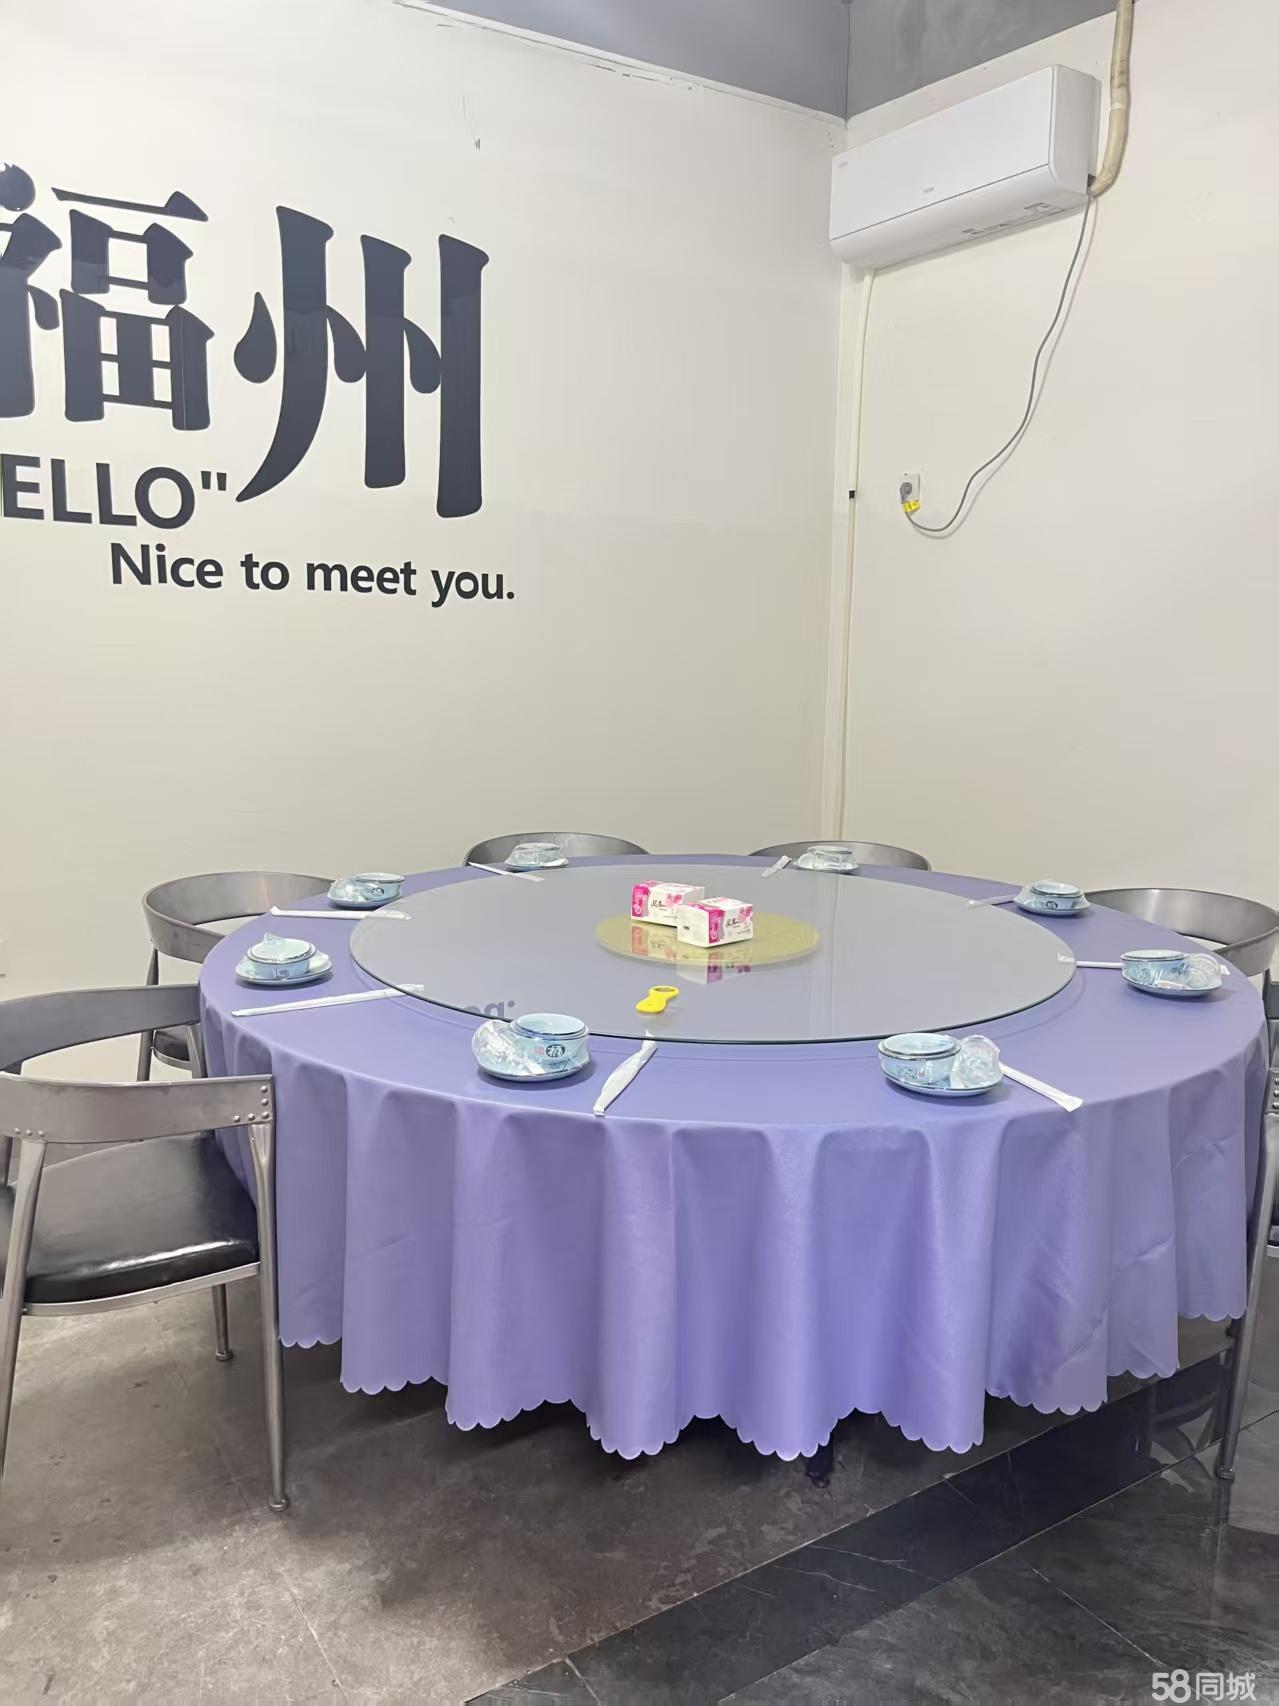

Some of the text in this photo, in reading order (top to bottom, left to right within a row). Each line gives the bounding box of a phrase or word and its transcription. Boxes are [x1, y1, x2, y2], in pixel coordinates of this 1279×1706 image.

[0, 162, 489, 519] 福州
[110, 542, 515, 609] Nice to meet you.
